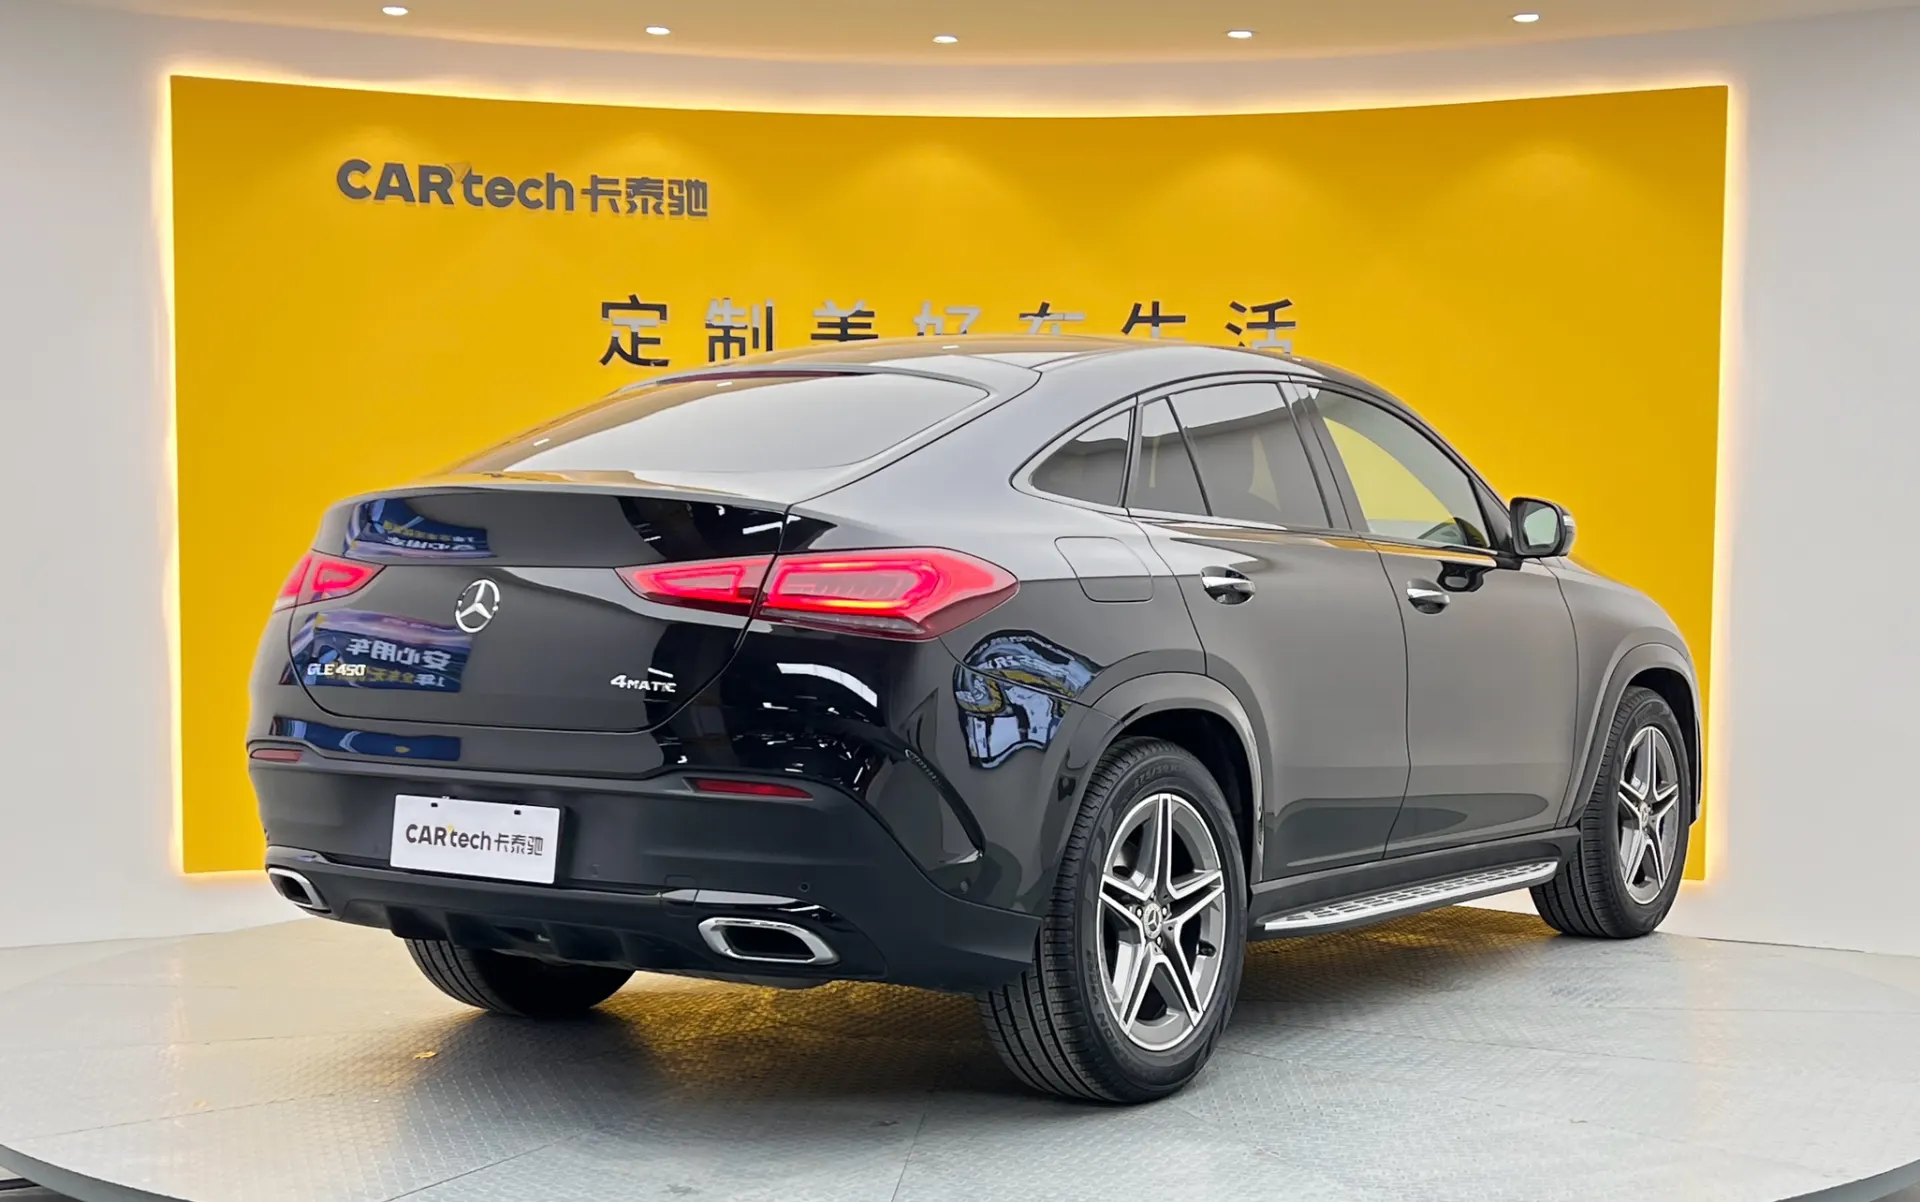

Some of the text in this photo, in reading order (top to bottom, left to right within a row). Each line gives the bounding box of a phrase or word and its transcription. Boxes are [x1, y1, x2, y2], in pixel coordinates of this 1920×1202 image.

[337, 158, 709, 218] CARtech 卡泰驰
[307, 663, 367, 677] GLE 450
[610, 674, 677, 693] 4MATIC
[405, 823, 544, 856] CARtech 卡泰驰
